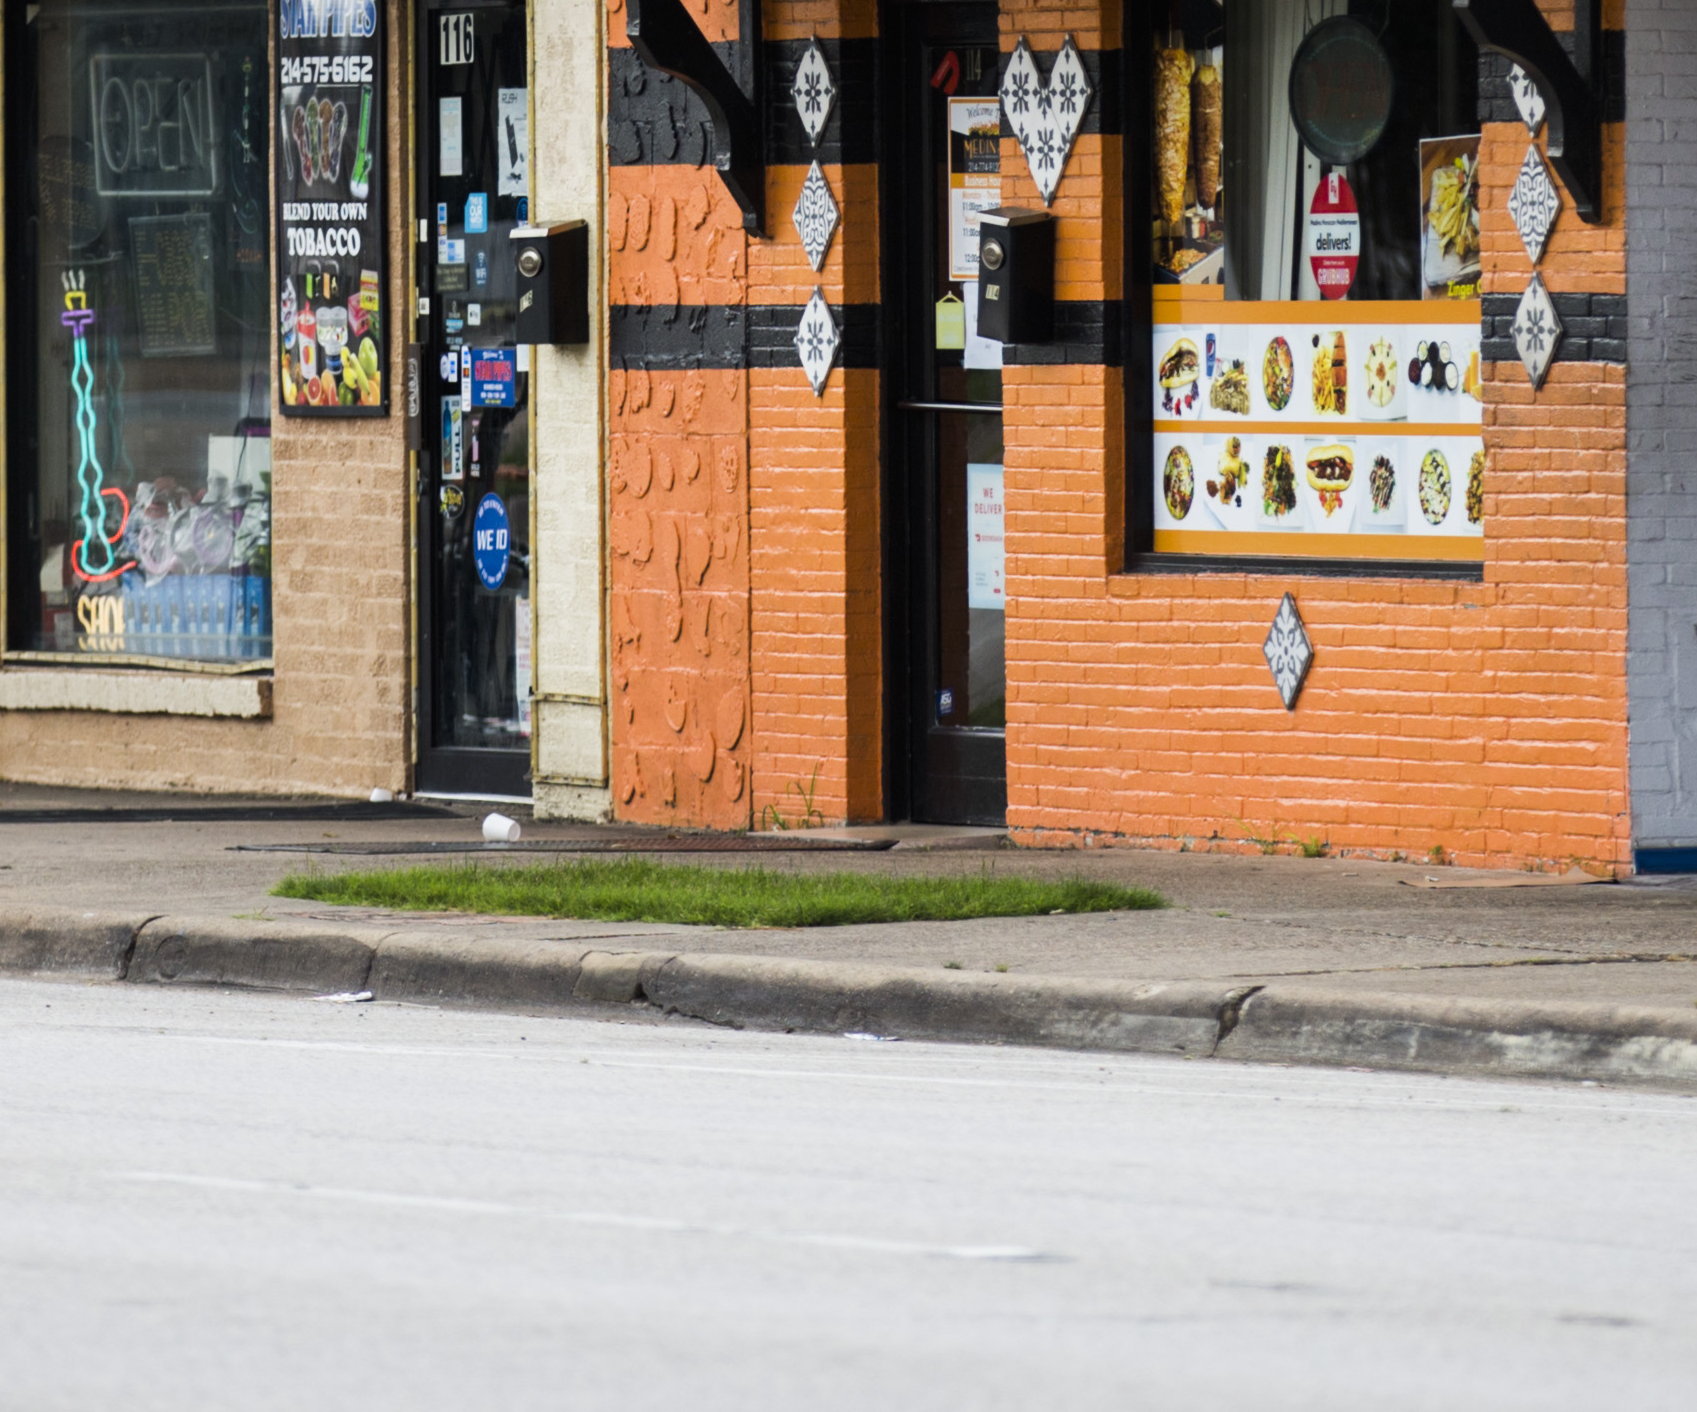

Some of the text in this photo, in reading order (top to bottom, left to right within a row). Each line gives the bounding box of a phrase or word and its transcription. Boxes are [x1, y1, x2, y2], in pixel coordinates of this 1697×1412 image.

[443, 15, 473, 63] 116
[281, 56, 373, 84] 214-575-6162
[966, 49, 982, 82] 114
[100, 77, 208, 174] OPEN
[283, 202, 367, 221] BLEND YOUR OWN
[287, 227, 361, 257] TOBACCO
[1316, 232, 1351, 251] delivers!
[1447, 280, 1474, 300] Zinger
[982, 487, 994, 499] WE
[974, 503, 1003, 515] DELIVER
[477, 528, 508, 551] WE ID
